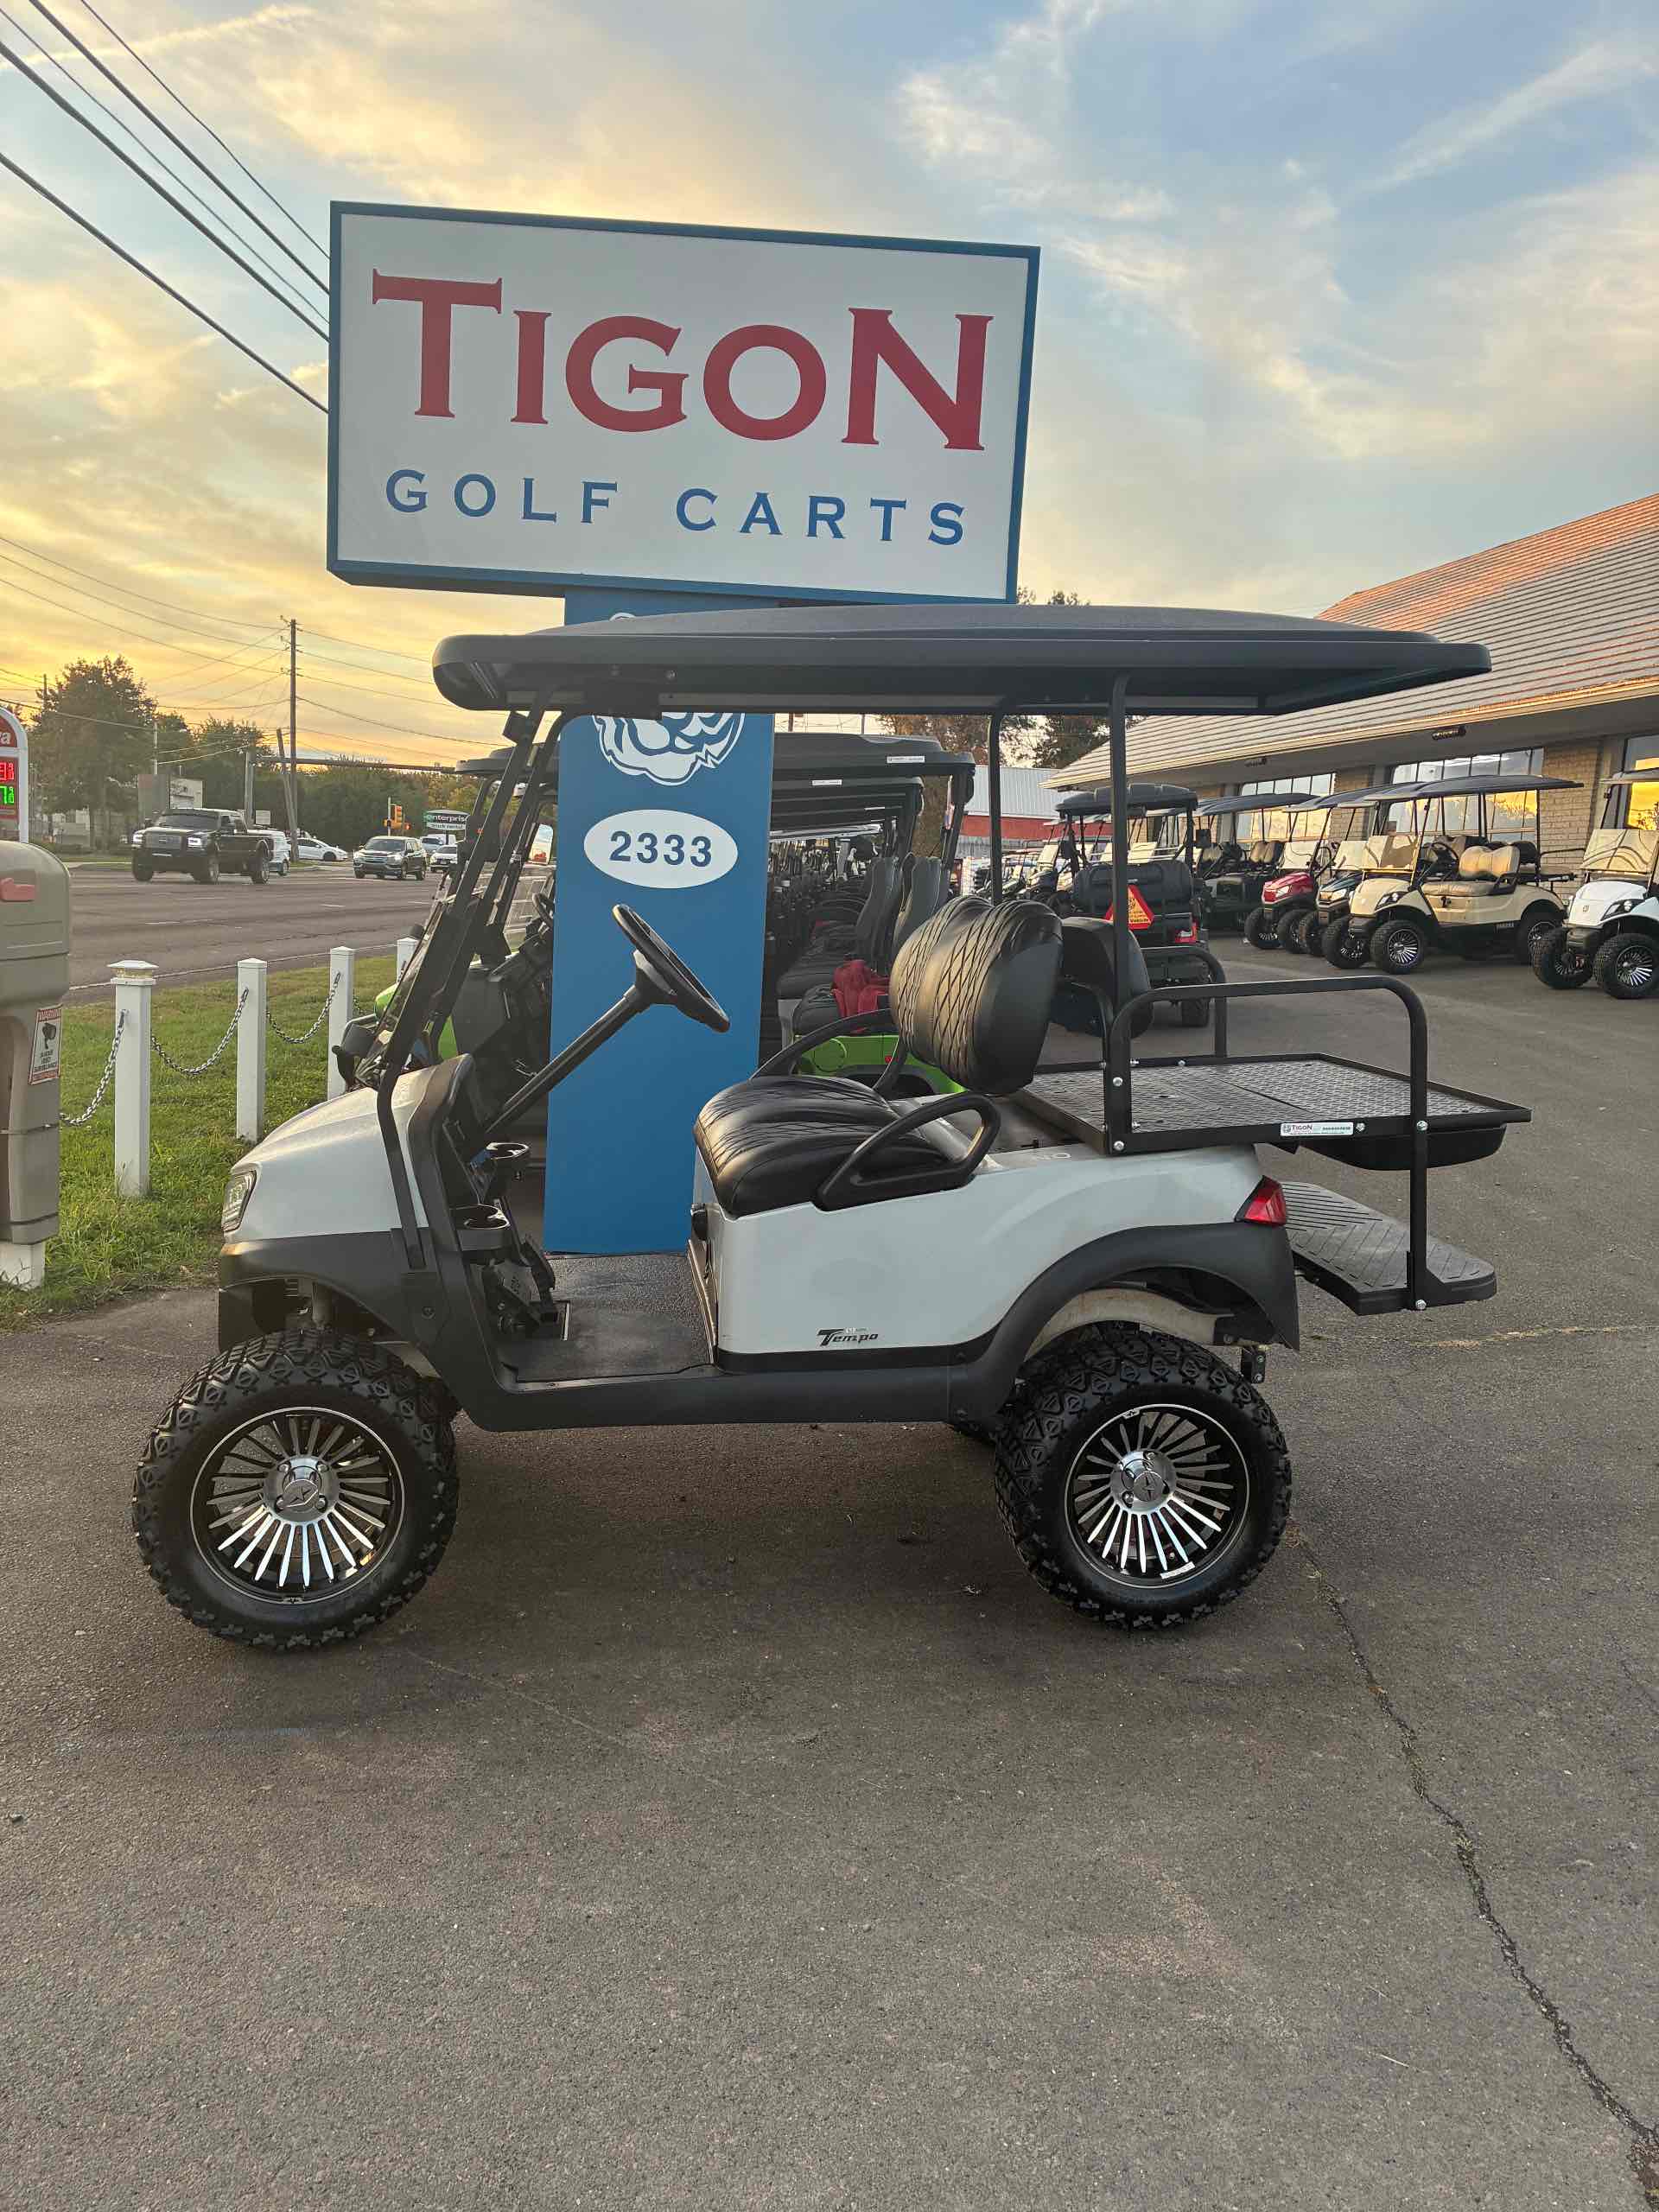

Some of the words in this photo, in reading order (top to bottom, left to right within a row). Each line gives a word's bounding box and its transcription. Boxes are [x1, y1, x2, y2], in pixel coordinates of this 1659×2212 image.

[372, 269, 994, 451] TIGON
[385, 469, 618, 524] GOLF
[676, 488, 965, 545] CARTS
[609, 830, 711, 867] 2333
[817, 1328, 879, 1346] Tempo
